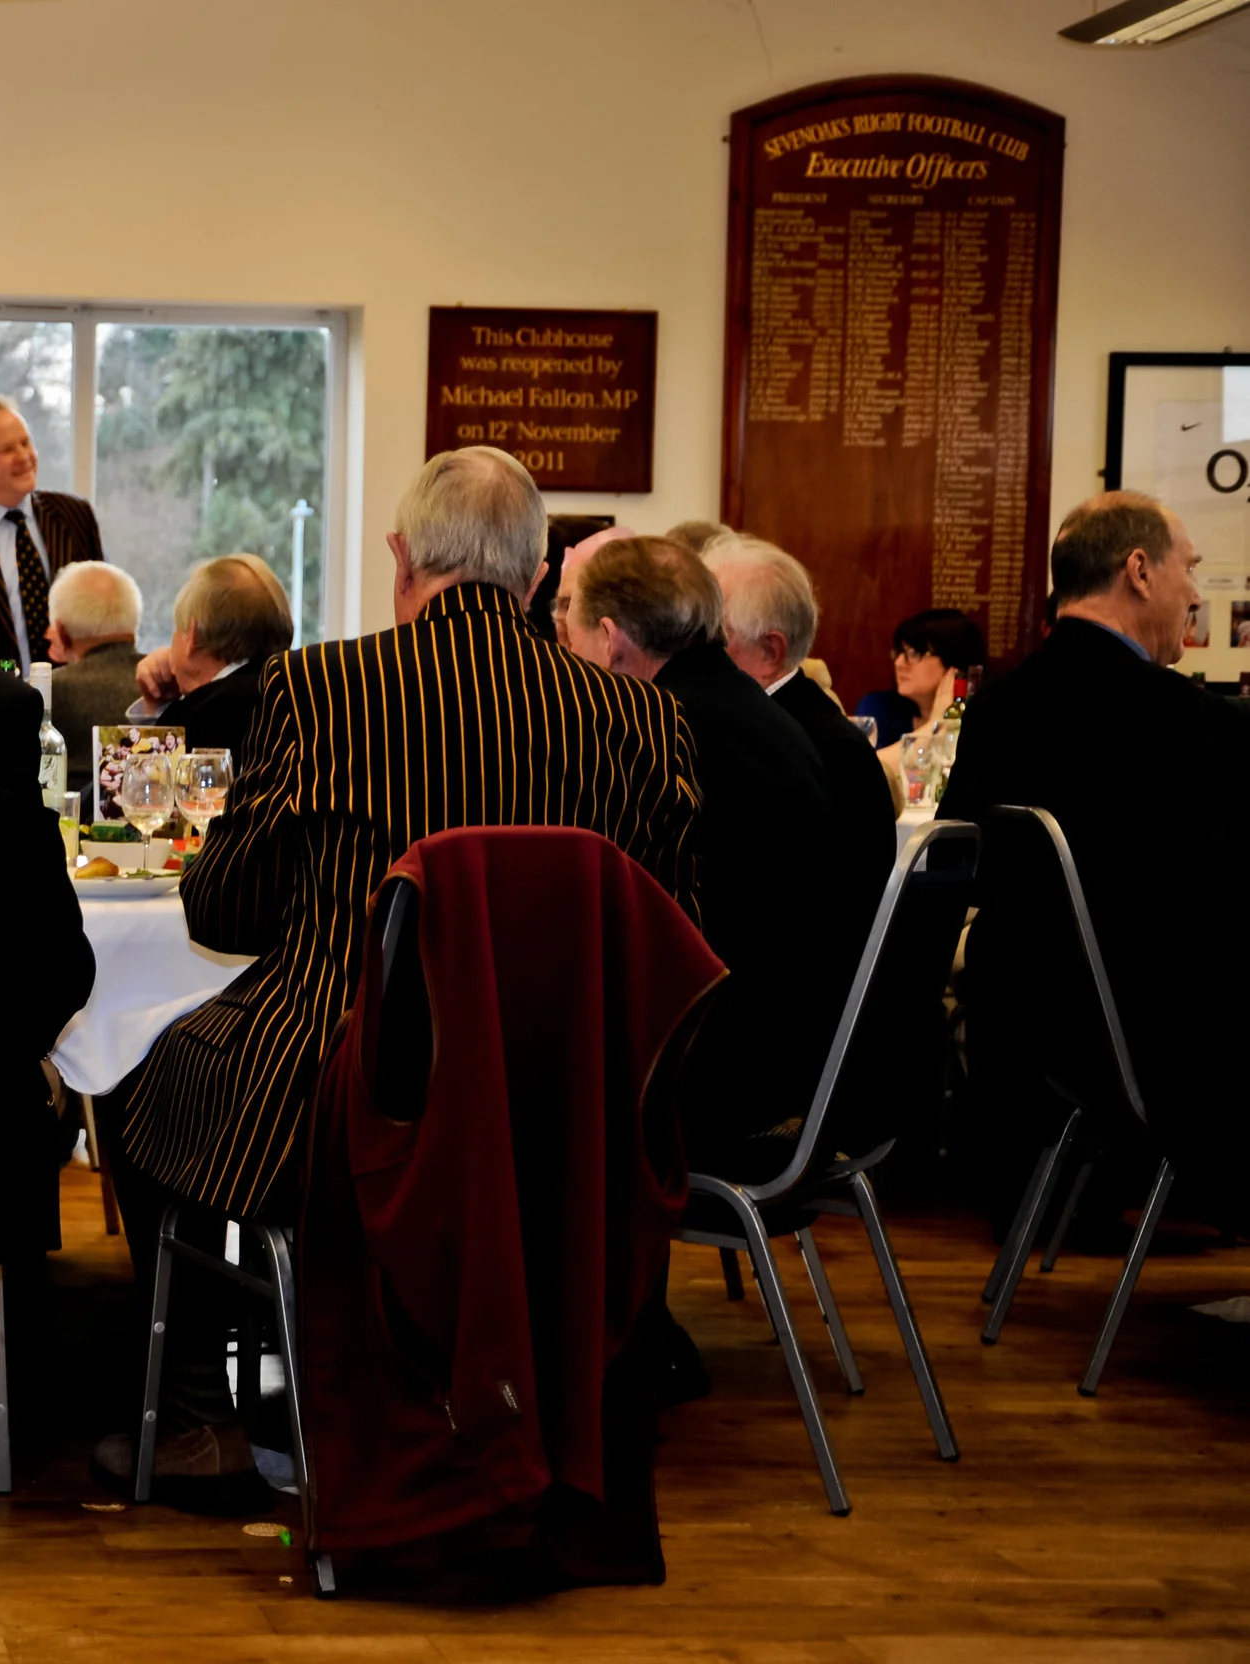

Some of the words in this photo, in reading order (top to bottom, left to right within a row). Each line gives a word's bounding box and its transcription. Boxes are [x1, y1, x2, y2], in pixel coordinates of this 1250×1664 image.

[763, 117, 851, 160] SEVENOAKS
[854, 112, 905, 135] RUGBY
[907, 113, 986, 145] FOOTBALL
[988, 131, 1030, 161] CLUB
[805, 151, 903, 178] Executive
[905, 152, 989, 189] Officers
[472, 326, 513, 346] This
[516, 327, 613, 347] Clubhouse
[460, 356, 497, 372] was
[502, 355, 593, 379] reopened
[598, 355, 623, 379] by
[440, 385, 523, 407] Michael
[601, 389, 638, 409] MP
[457, 422, 483, 440] on
[517, 421, 620, 443] November
